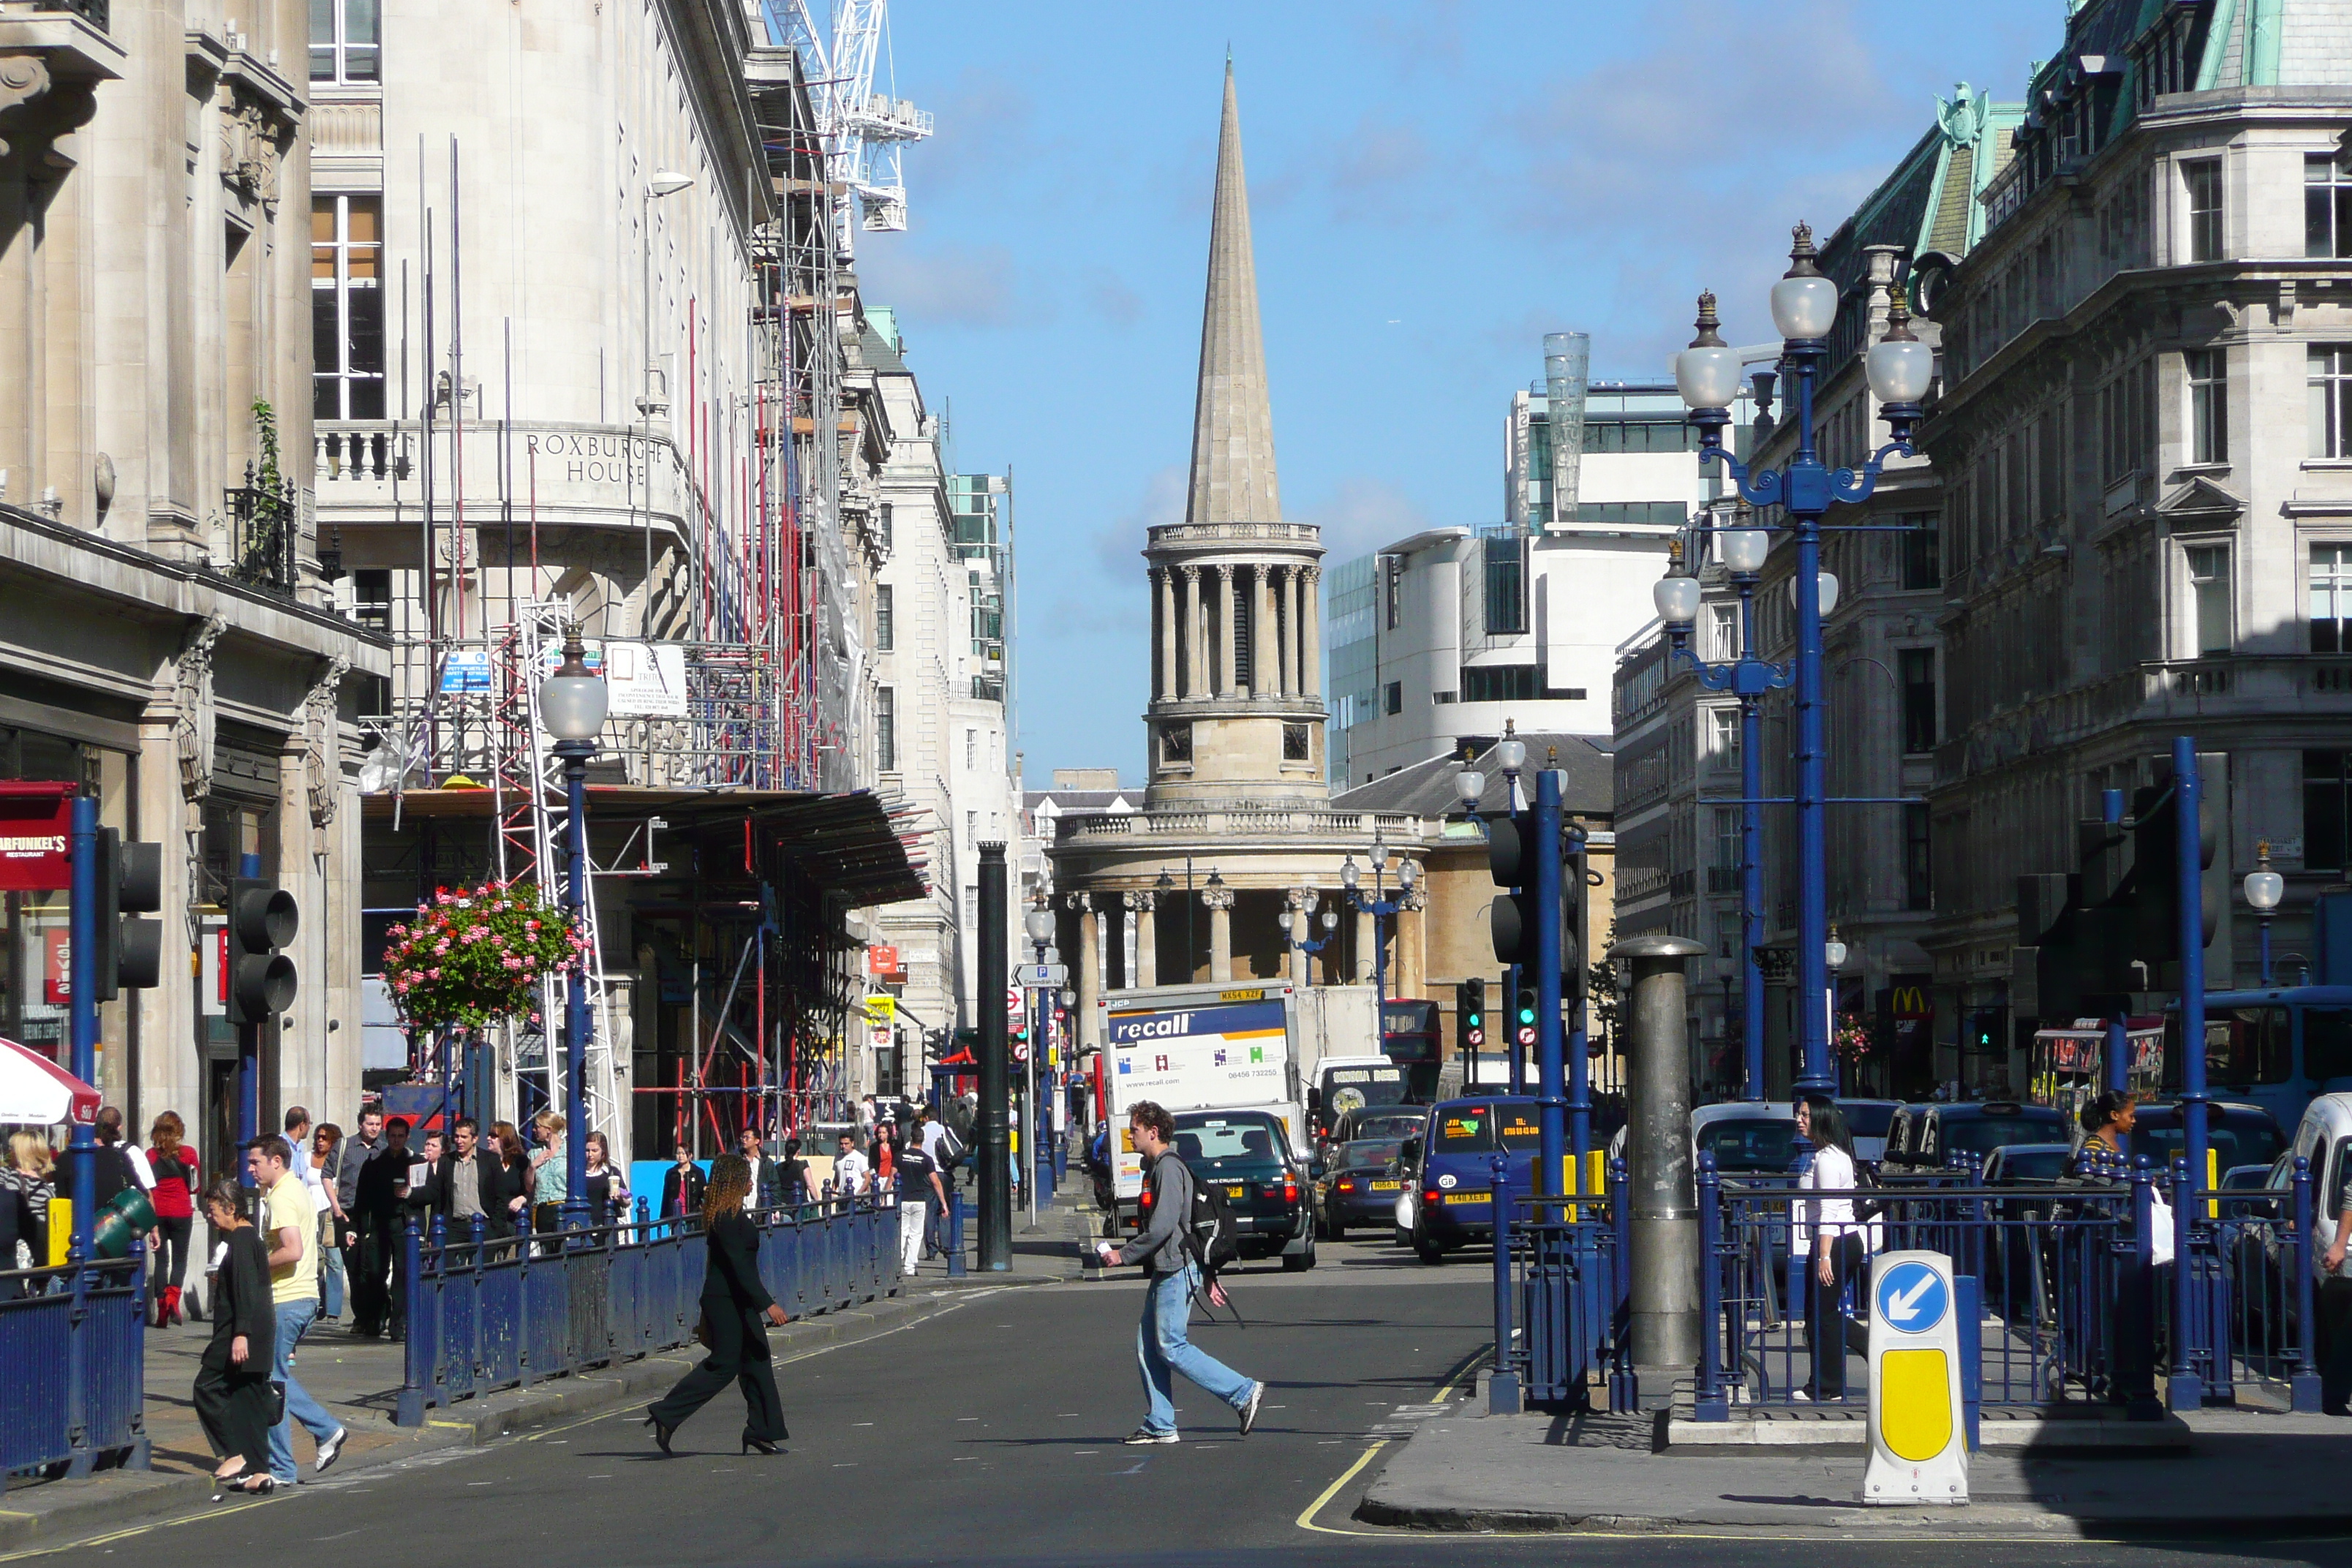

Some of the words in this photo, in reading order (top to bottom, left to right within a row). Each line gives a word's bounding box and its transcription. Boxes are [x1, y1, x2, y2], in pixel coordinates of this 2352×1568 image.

[527, 434, 662, 464] ROXBURGHE
[568, 461, 645, 486] HOUSE
[1222, 992, 1243, 1000] MX54
[1245, 990, 1261, 999] XZF
[1117, 1013, 1190, 1039] recall
[1126, 1078, 1180, 1088] www.recall.com
[1373, 1069, 1401, 1082] BEER
